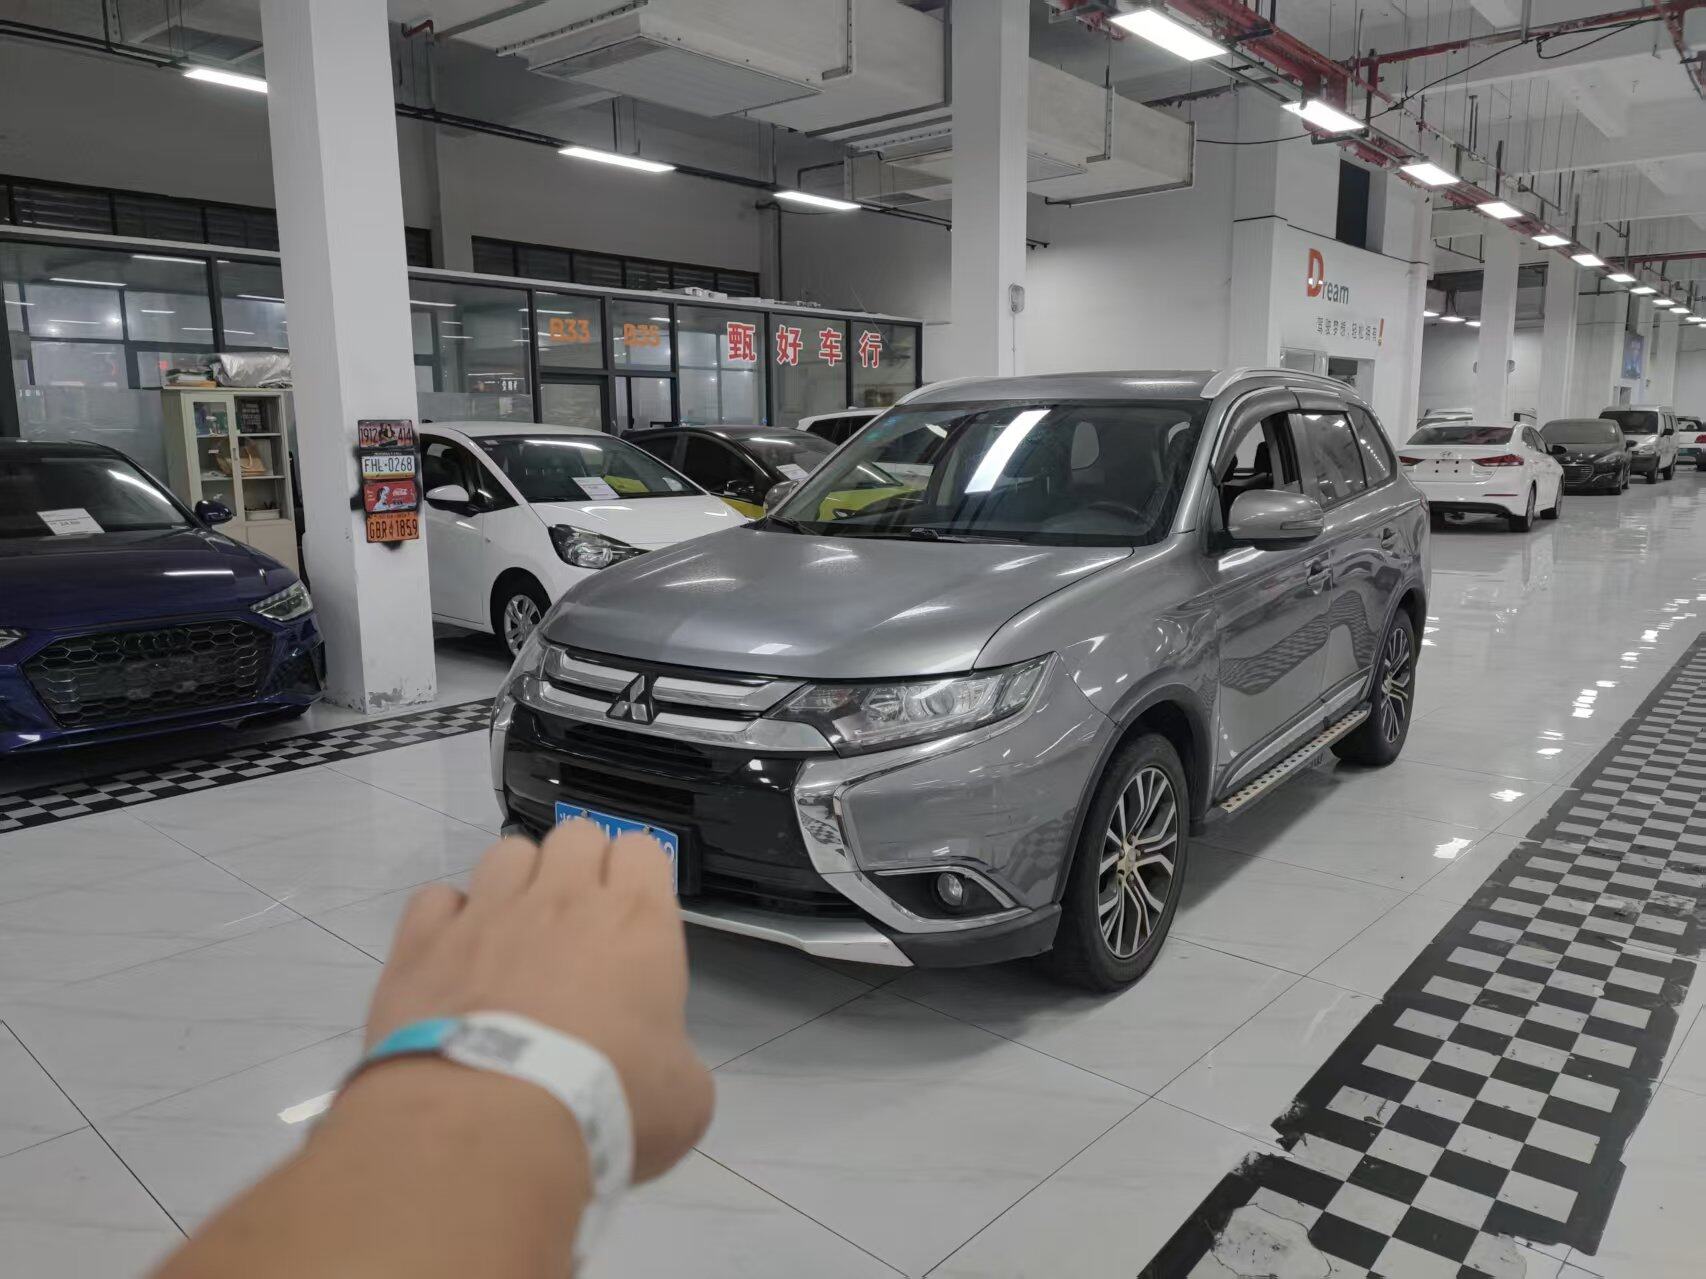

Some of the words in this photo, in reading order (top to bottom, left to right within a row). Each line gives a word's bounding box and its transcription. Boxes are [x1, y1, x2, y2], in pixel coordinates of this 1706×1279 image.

[1307, 248, 1349, 304] Dream
[727, 321, 882, 368] 甄好车行
[369, 521, 387, 539] GBR
[395, 518, 417, 537] 1859
